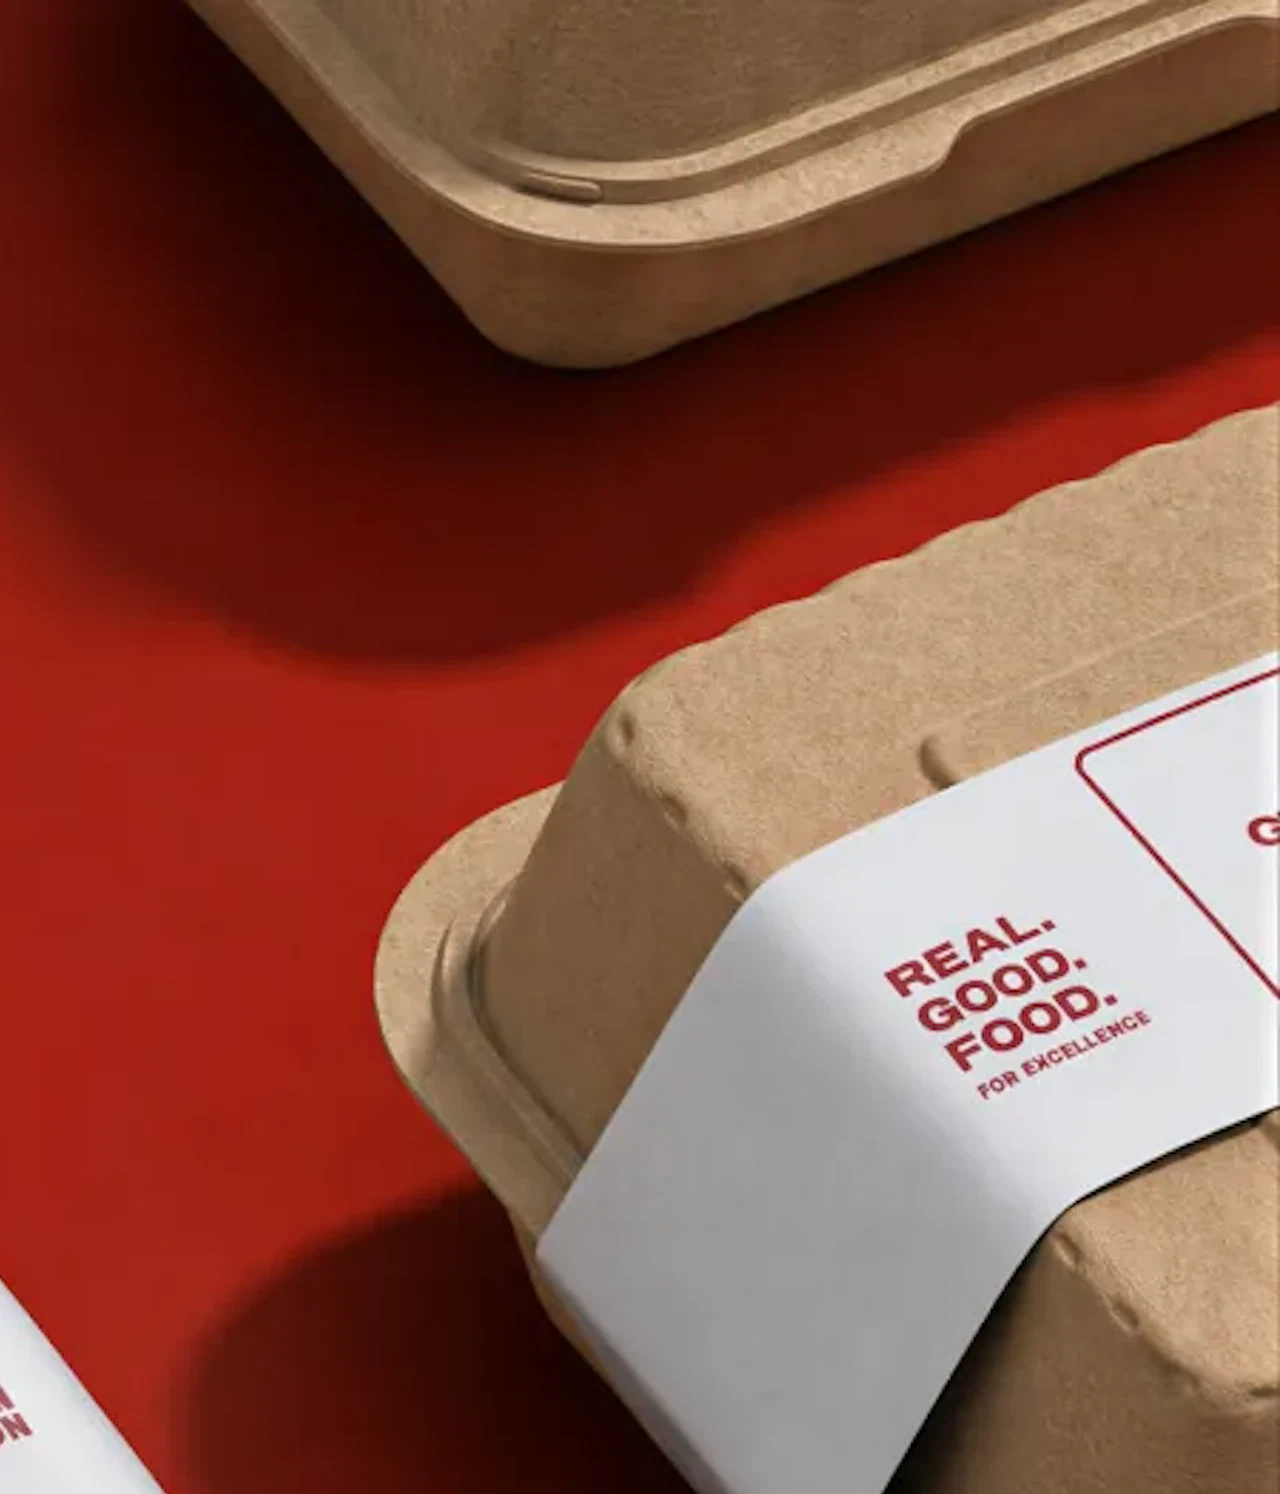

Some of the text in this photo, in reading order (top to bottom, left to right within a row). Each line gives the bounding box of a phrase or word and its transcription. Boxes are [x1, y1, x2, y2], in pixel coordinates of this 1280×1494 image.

[884, 916, 1057, 997] REAL.
[917, 948, 1088, 1032] GOOD.
[945, 985, 1118, 1072] FOOD.
[977, 1070, 1020, 1100] FOR
